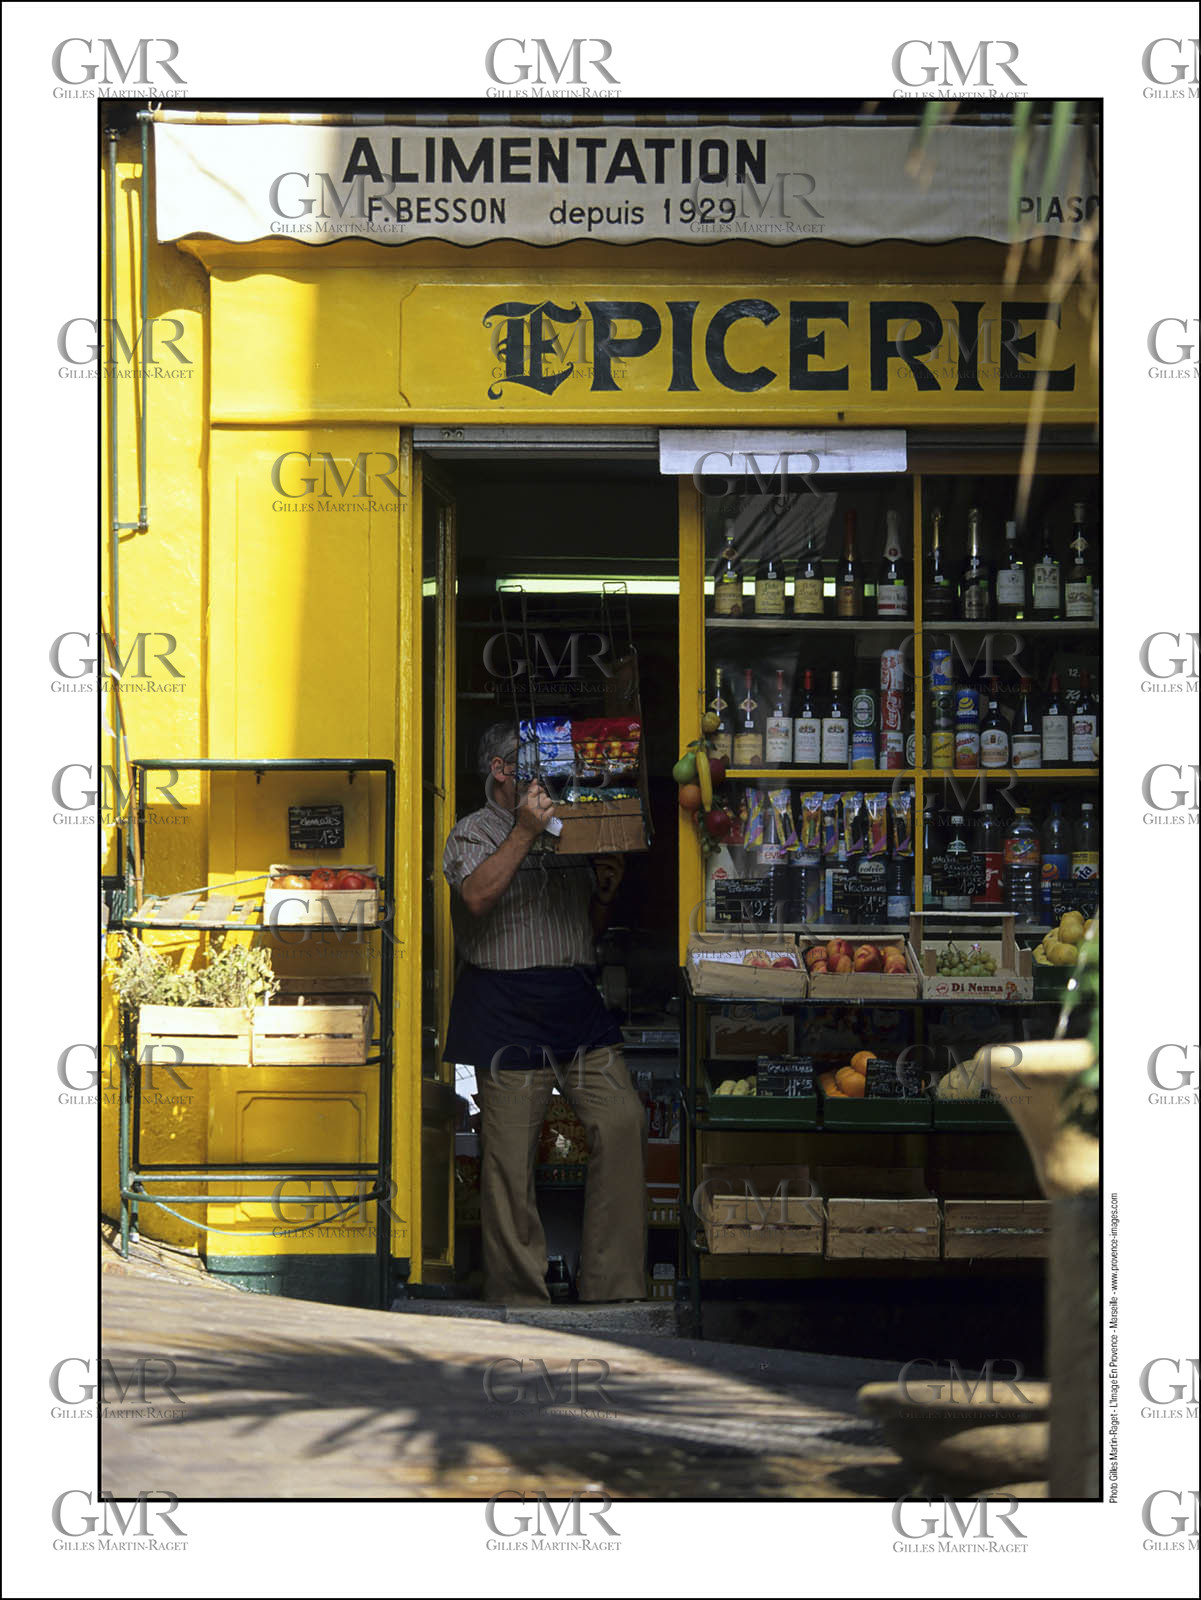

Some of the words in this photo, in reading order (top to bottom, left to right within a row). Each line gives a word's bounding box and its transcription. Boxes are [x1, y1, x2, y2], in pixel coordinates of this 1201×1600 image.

[342, 137, 767, 184] ALIMENTATION
[367, 197, 507, 224] F.BESSON
[549, 198, 644, 232] depuis
[663, 198, 736, 225] 1929
[484, 298, 1077, 401] EPICERIE
[952, 983, 964, 993] Di
[968, 983, 1003, 993] Nanna
